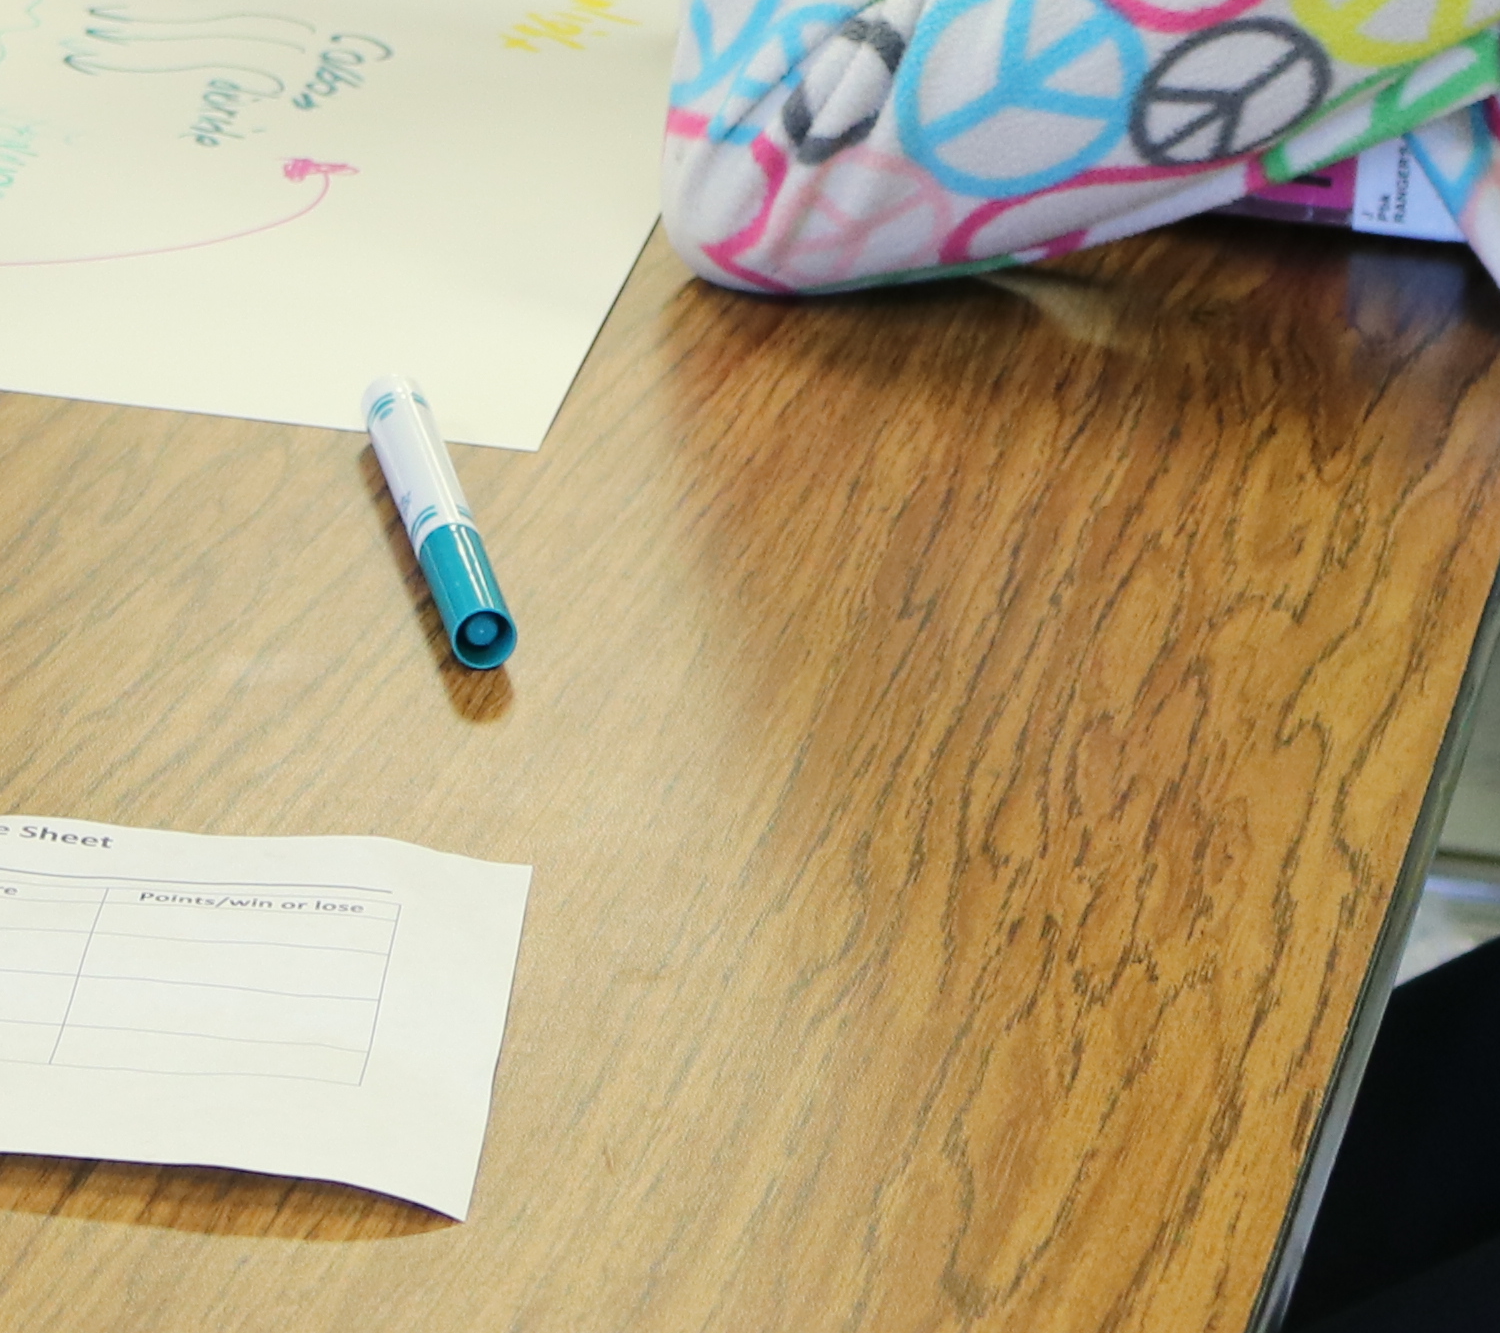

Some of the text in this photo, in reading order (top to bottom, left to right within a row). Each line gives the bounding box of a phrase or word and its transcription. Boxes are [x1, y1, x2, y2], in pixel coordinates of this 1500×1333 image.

[19, 825, 114, 850] Sheet
[139, 891, 365, 914] Points/win or lose
